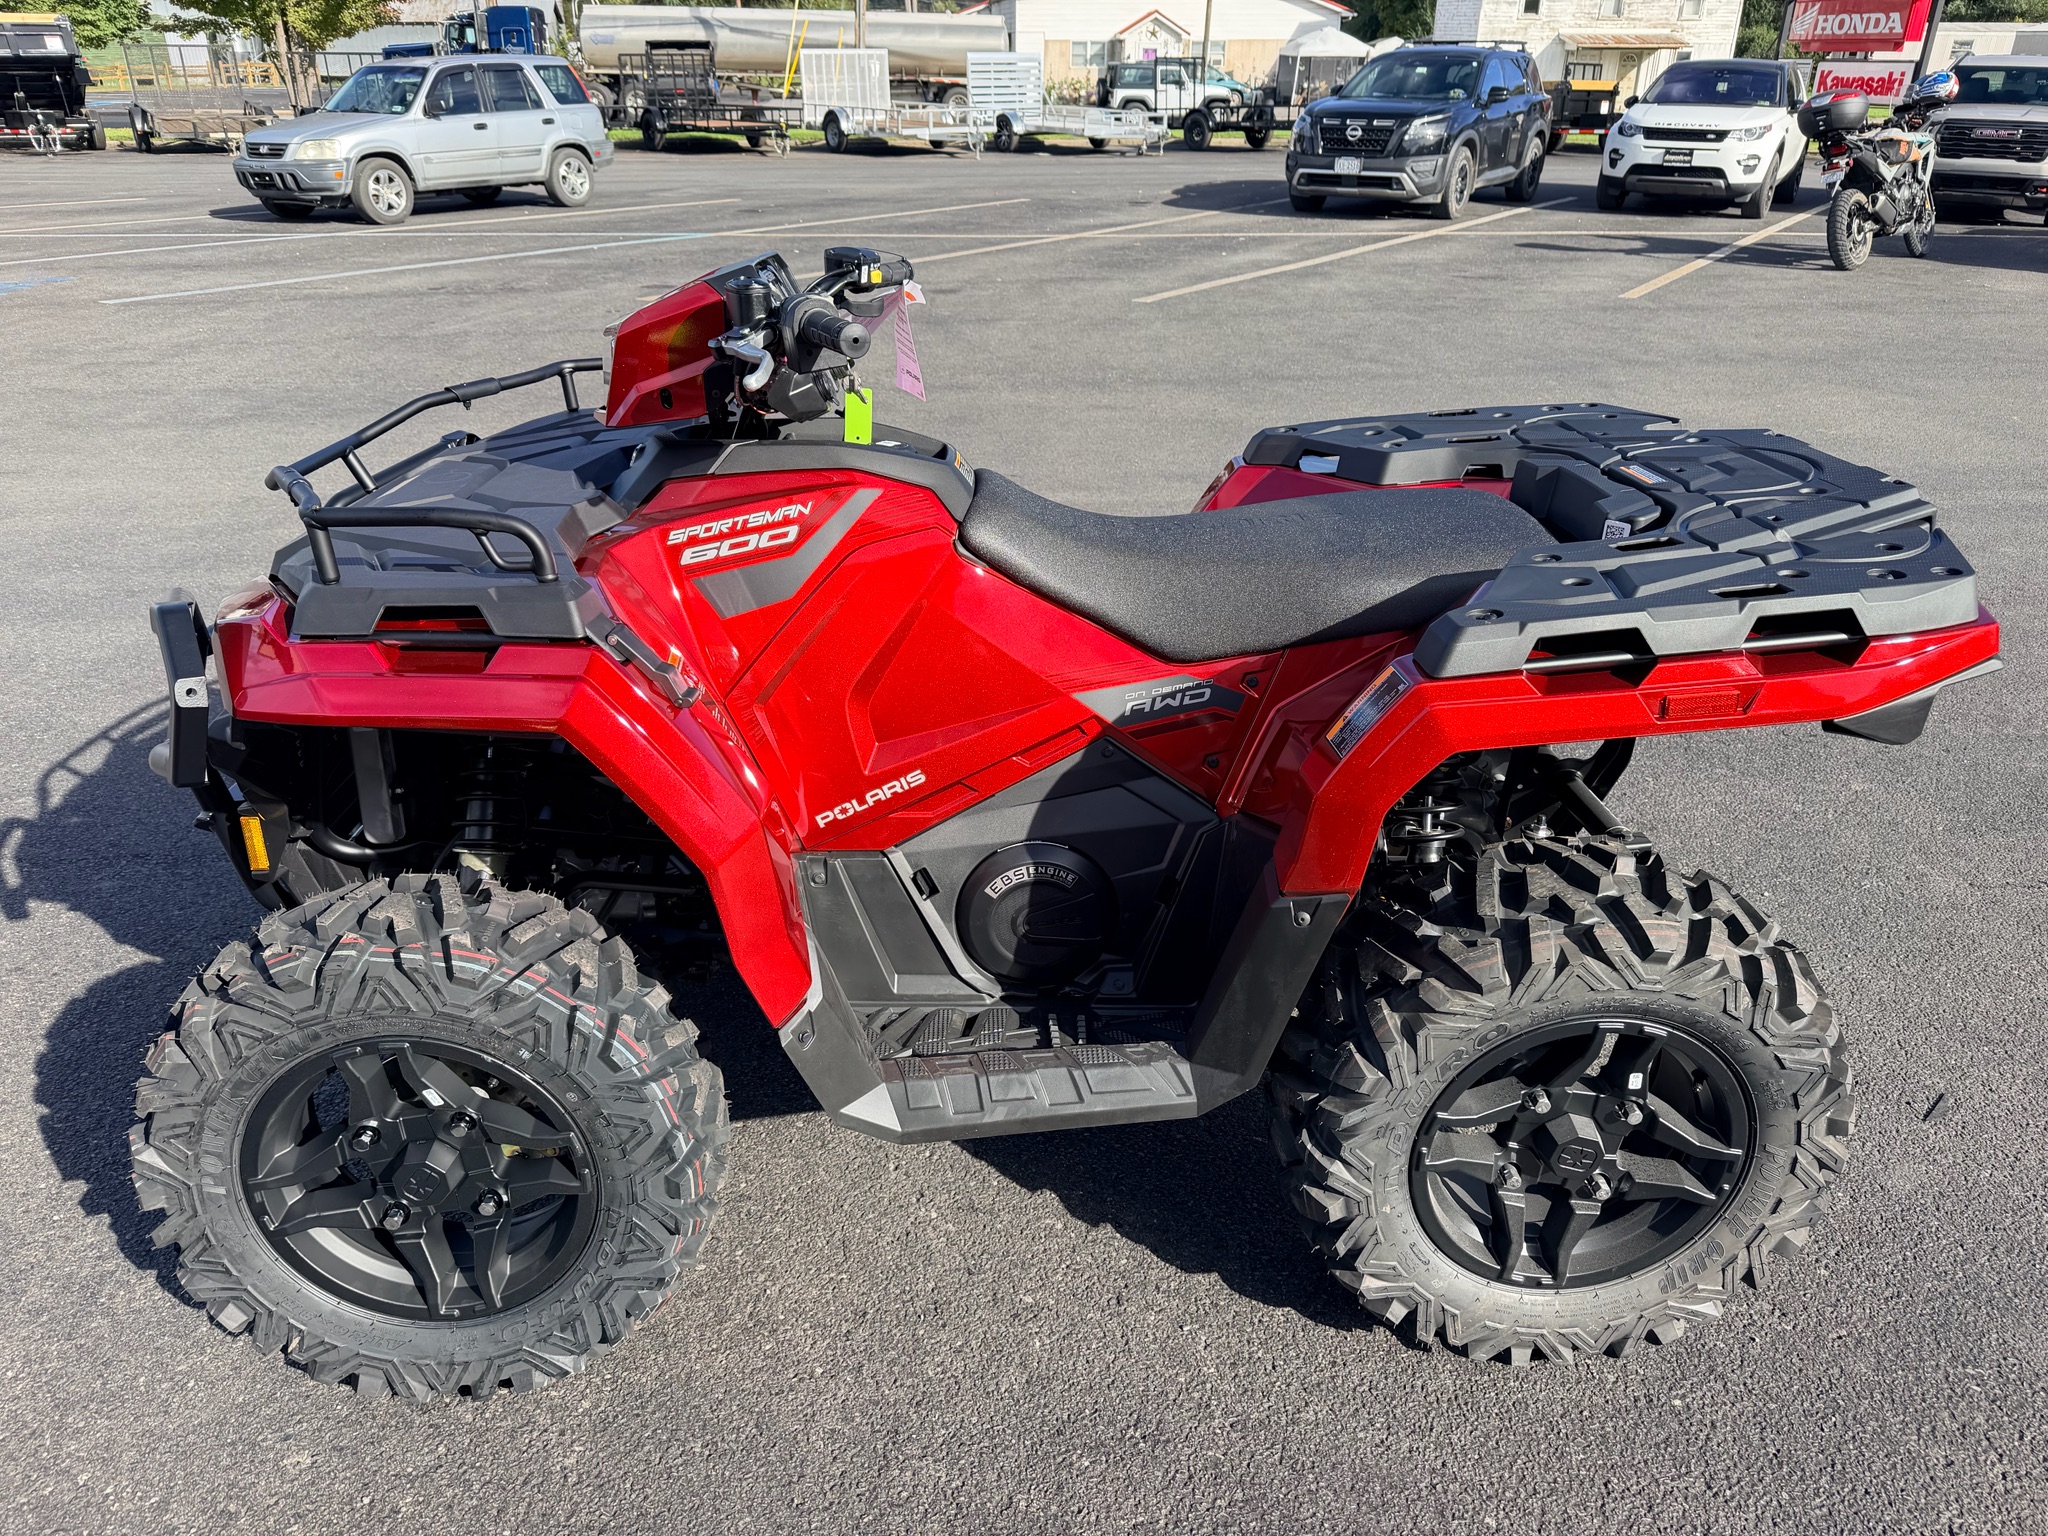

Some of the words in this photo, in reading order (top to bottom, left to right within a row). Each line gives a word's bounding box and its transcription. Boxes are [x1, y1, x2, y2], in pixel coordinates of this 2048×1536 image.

[1814, 12, 1903, 35] HONDA
[1816, 70, 1906, 98] Kawasaki
[666, 501, 813, 546] SPORTSMAN
[680, 524, 799, 566] 600
[1124, 687, 1212, 716] AWD
[1125, 690, 1146, 700] ON
[1151, 679, 1214, 695] DEMAND
[1348, 683, 1378, 715] WARNING
[814, 769, 926, 829] POLARIS
[989, 868, 1026, 895] EBS
[1028, 866, 1076, 883] ENGINE
[199, 1087, 249, 1196] POWER
[1728, 1143, 1789, 1240] POWER
[1657, 1239, 1726, 1296] GRIP
